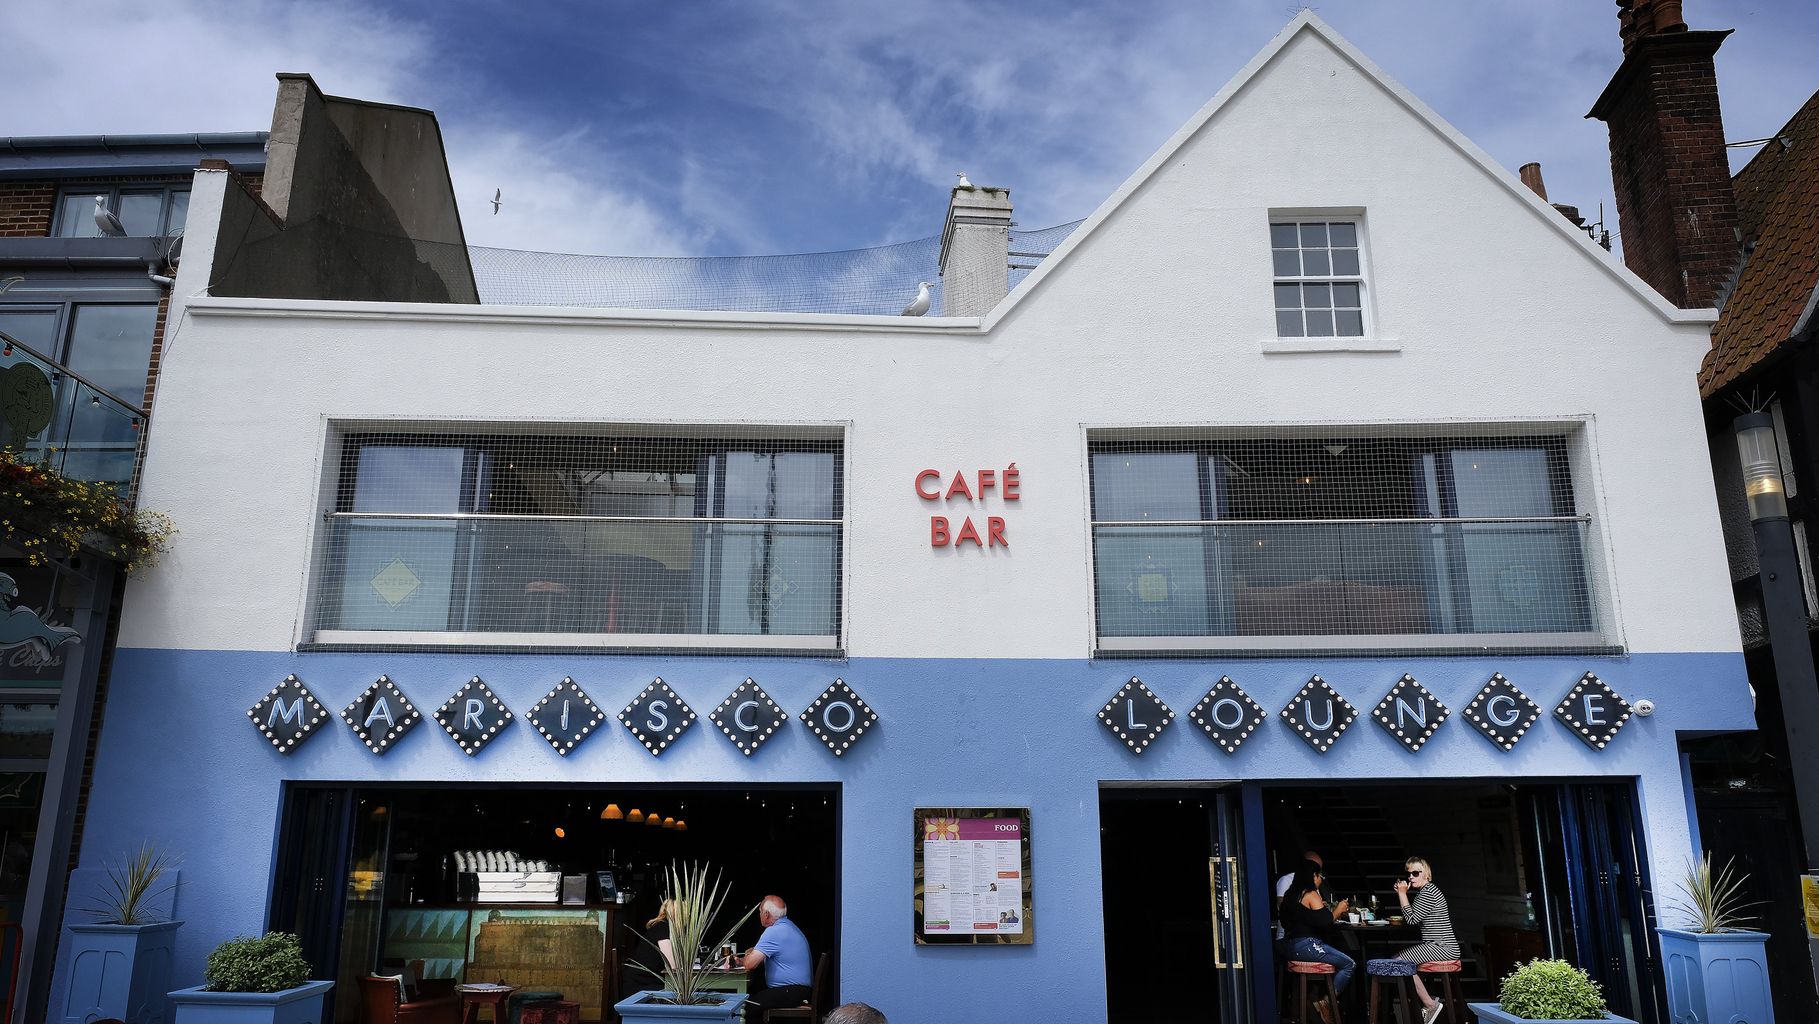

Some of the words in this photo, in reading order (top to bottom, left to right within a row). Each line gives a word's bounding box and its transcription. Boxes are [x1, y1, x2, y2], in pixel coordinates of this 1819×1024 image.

[915, 462, 1020, 500] CAFÉ
[931, 515, 1009, 547] BAR
[268, 696, 855, 732] MARISCO
[1127, 694, 1607, 731] LOUNGE
